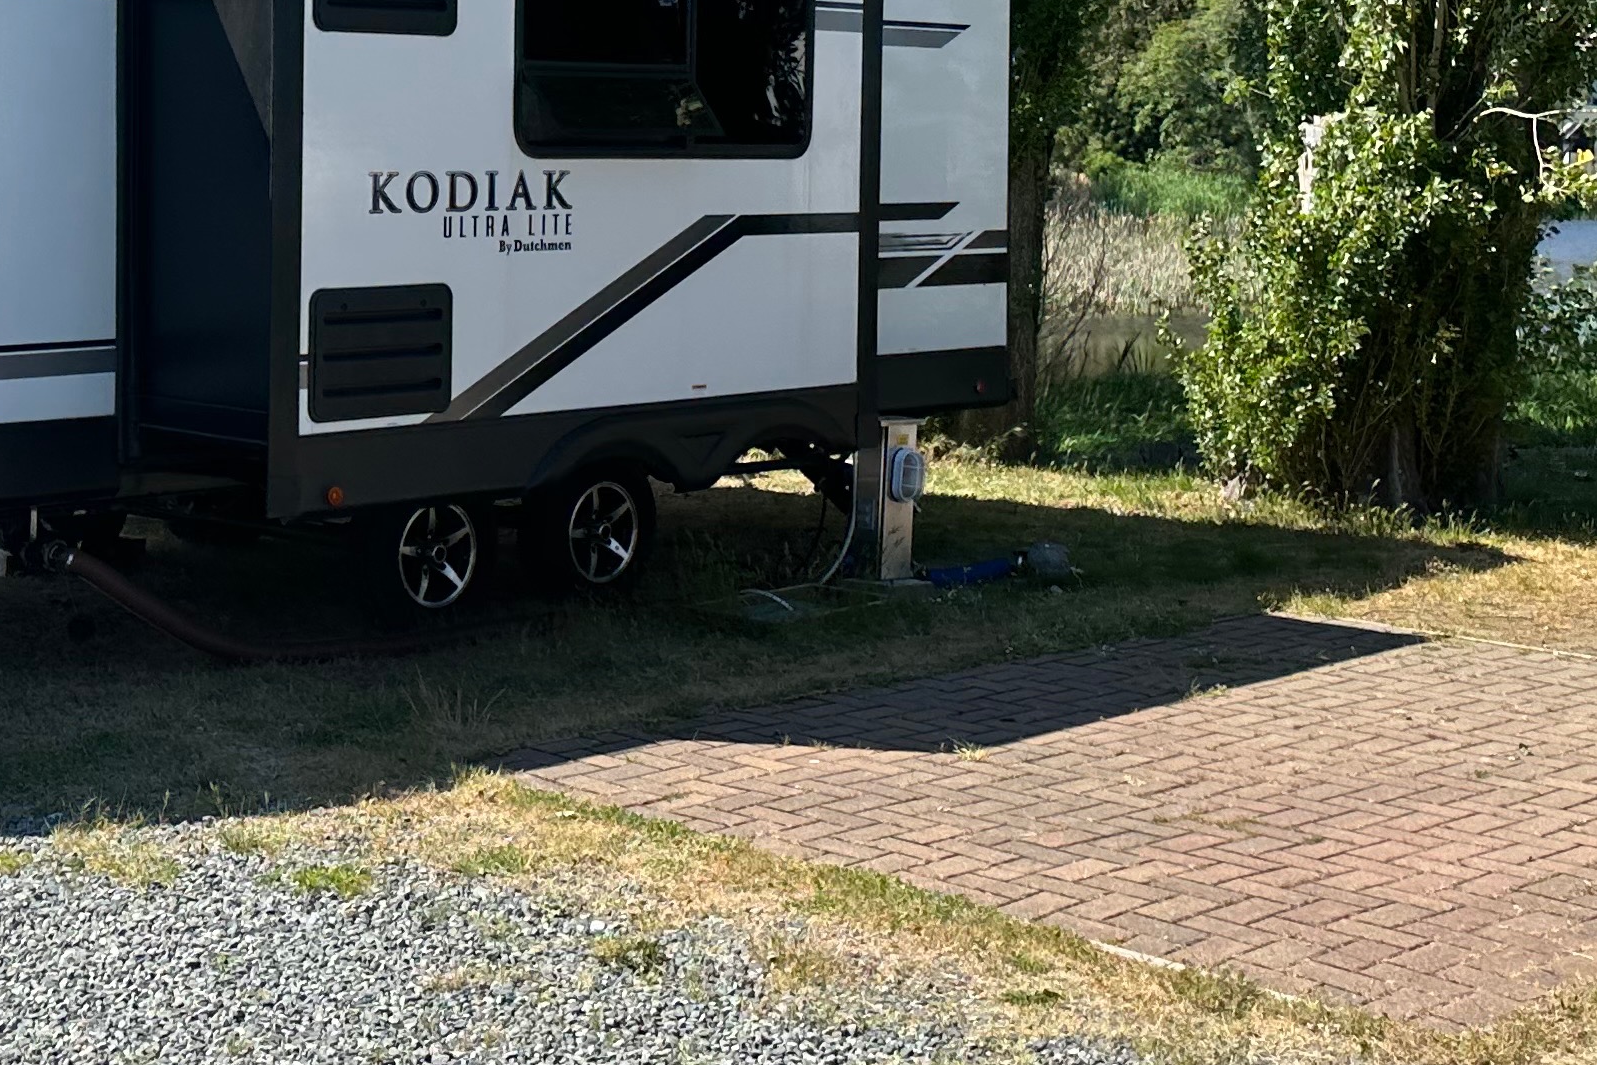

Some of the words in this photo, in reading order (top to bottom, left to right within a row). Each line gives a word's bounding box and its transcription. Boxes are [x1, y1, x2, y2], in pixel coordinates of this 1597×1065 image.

[368, 169, 573, 214] KODIAK
[443, 216, 510, 238] ULTRA
[528, 214, 573, 236] LITE
[499, 241, 512, 255] By
[513, 239, 572, 253] Dutchmen
